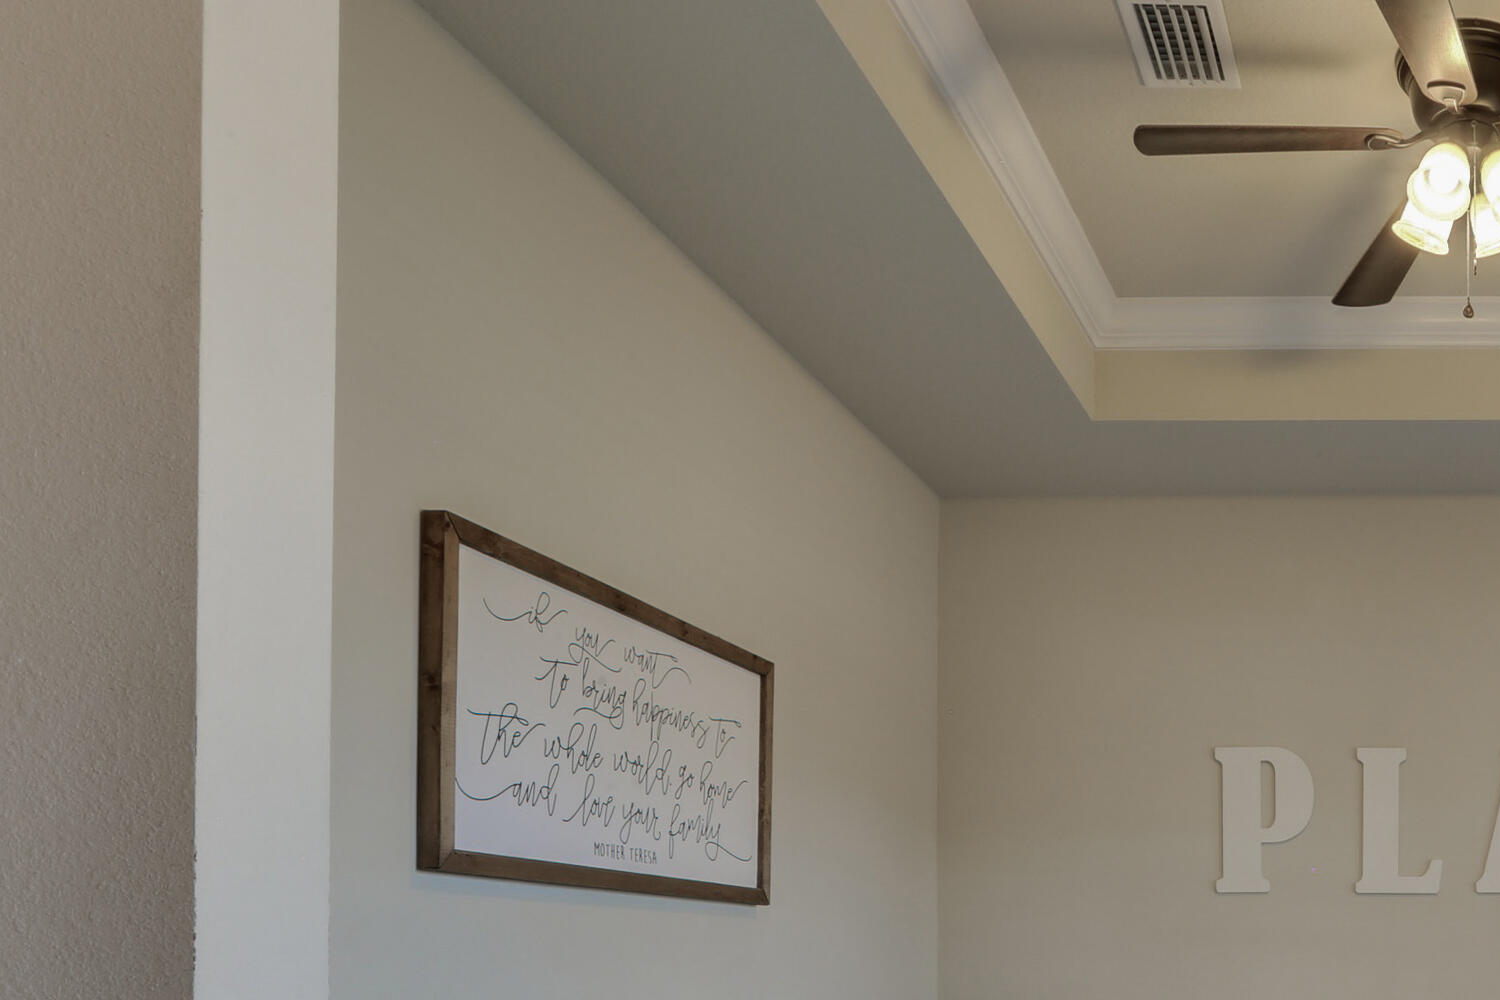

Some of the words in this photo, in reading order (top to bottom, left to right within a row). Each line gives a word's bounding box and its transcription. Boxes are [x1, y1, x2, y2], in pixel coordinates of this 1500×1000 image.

[568, 627, 622, 673] you
[624, 646, 692, 689] want
[534, 656, 580, 709] to
[573, 657, 627, 730] bring
[632, 678, 711, 749] happiness
[709, 716, 742, 760] to
[466, 702, 546, 765] the
[543, 722, 603, 774] whole
[675, 764, 695, 800] go
[699, 761, 750, 809] home
[562, 773, 616, 828] love
[619, 802, 662, 845] your
[669, 798, 752, 862] family
[593, 841, 625, 860] MOTHER
[629, 847, 657, 865] TERESA
